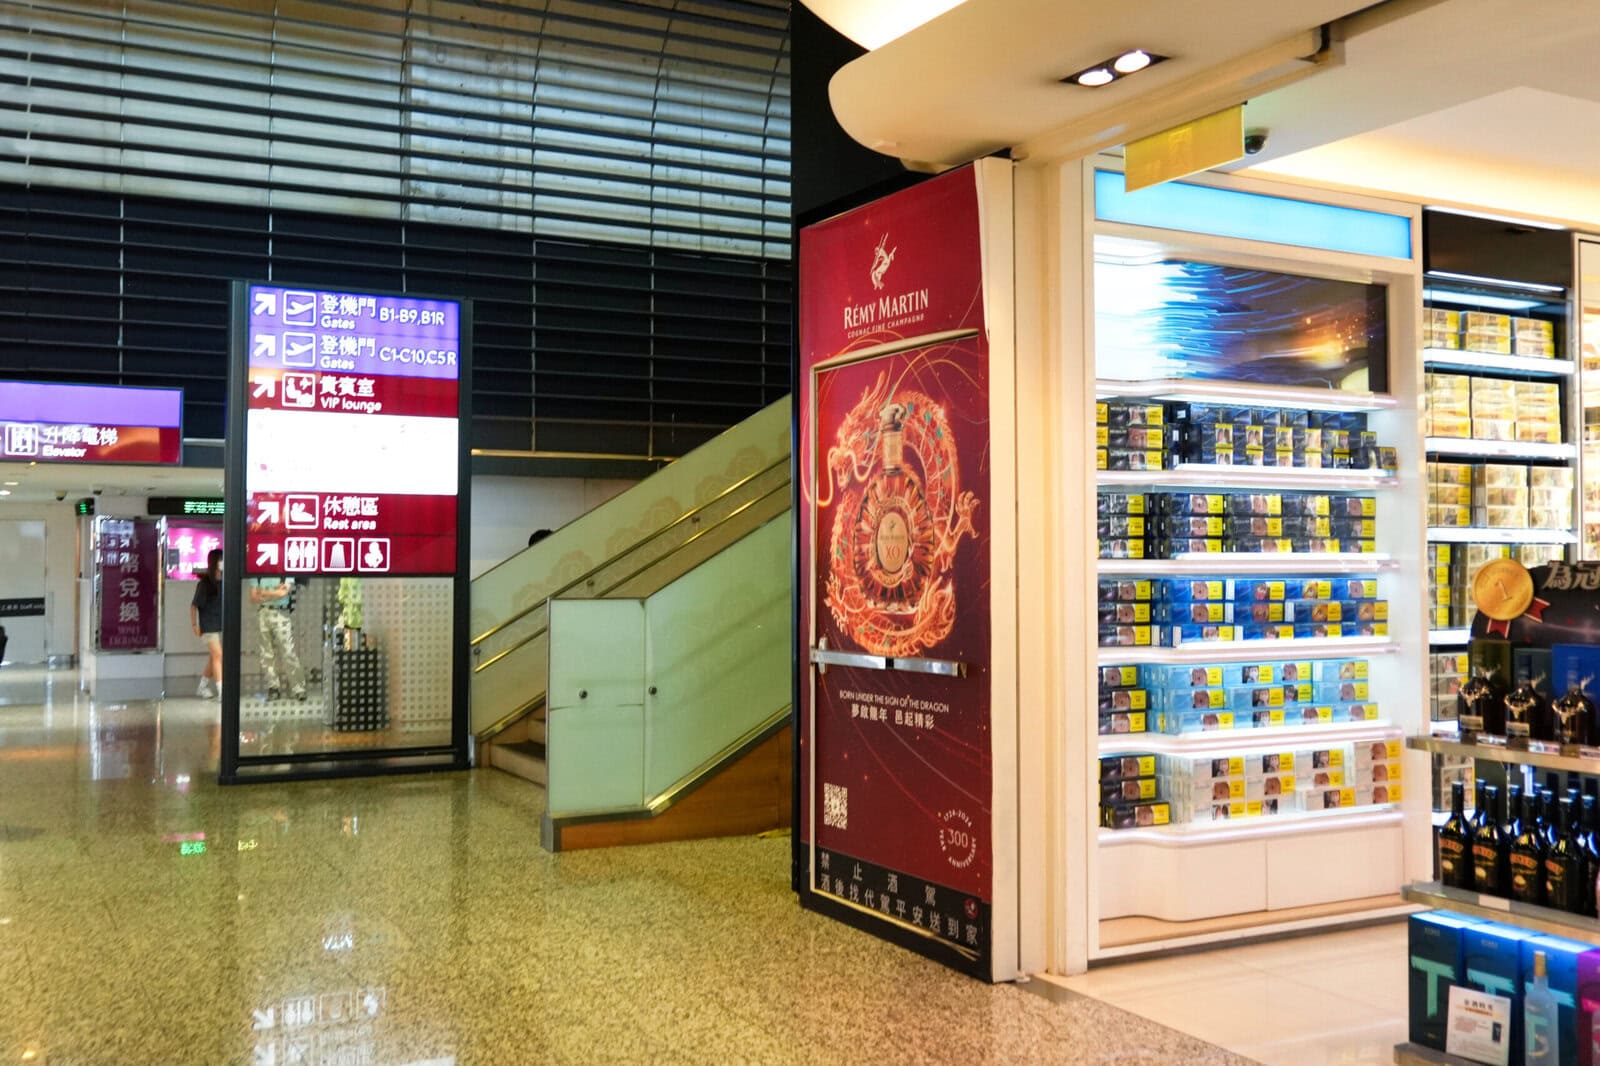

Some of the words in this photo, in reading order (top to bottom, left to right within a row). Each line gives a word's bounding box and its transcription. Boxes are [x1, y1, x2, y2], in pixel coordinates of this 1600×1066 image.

[320, 294, 377, 318] 登機門
[379, 307, 445, 326] B1-B9,B1R
[844, 302, 876, 329] RÉMY
[878, 288, 929, 321] MARTIN
[321, 316, 355, 330] Gates
[847, 326, 870, 339] COGNAC
[872, 322, 885, 332] FINE
[888, 313, 924, 329] CHAMPAGNE
[320, 335, 376, 358] 登機門
[320, 356, 355, 370] Gates
[319, 375, 376, 398] 貴賓室
[321, 396, 340, 409] VIP
[342, 398, 382, 413] lounge
[43, 426, 118, 446] 升降電梯
[42, 445, 87, 458] Elevator
[323, 496, 379, 517] 休憩區
[323, 517, 350, 530] Rest
[351, 519, 377, 530] area
[839, 689, 855, 700] BORN
[855, 692, 873, 703] UNDER
[874, 694, 884, 705] THE
[884, 695, 899, 706] SIGN
[900, 697, 908, 708] OF
[908, 699, 919, 709] THE
[920, 700, 949, 713] DRAGON
[947, 828, 968, 849] 300
